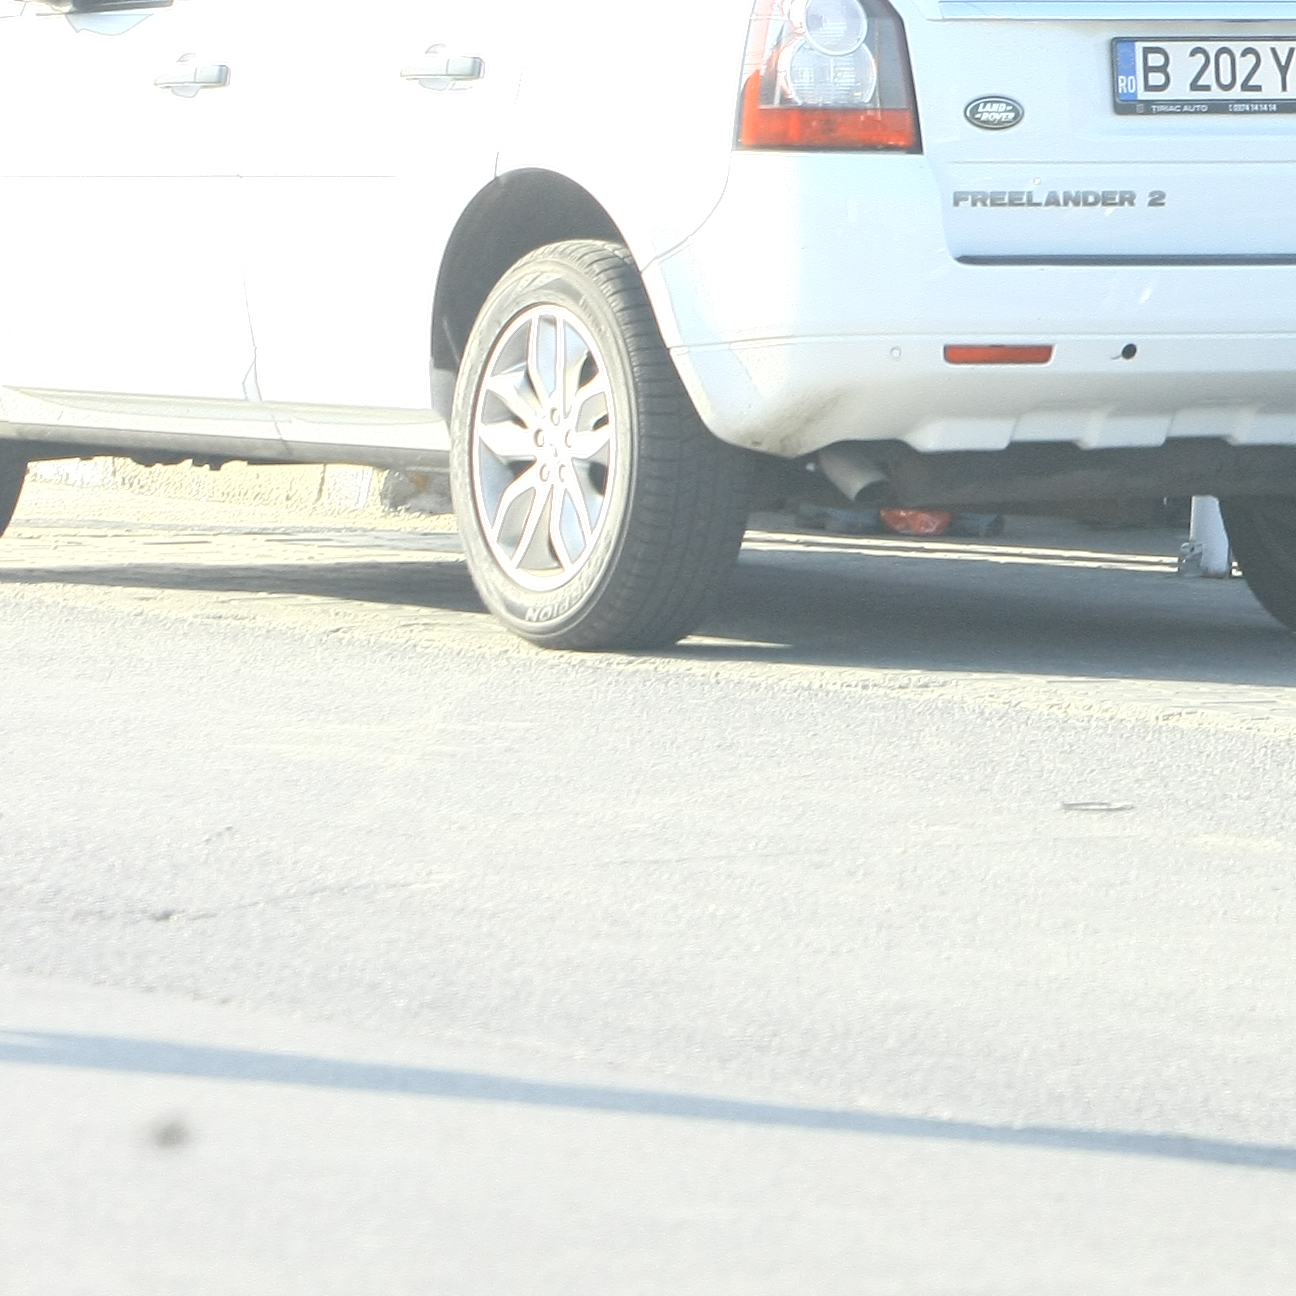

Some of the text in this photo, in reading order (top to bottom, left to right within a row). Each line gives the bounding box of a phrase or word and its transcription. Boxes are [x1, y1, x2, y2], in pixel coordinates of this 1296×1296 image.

[1142, 45, 1171, 93] B
[1188, 45, 1263, 93] 202
[1118, 75, 1136, 95] RO
[977, 102, 1007, 112] LAND
[1183, 104, 1208, 114] AUTO
[980, 112, 1015, 122] ROVER
[952, 189, 1166, 208] FREELANDER 2
